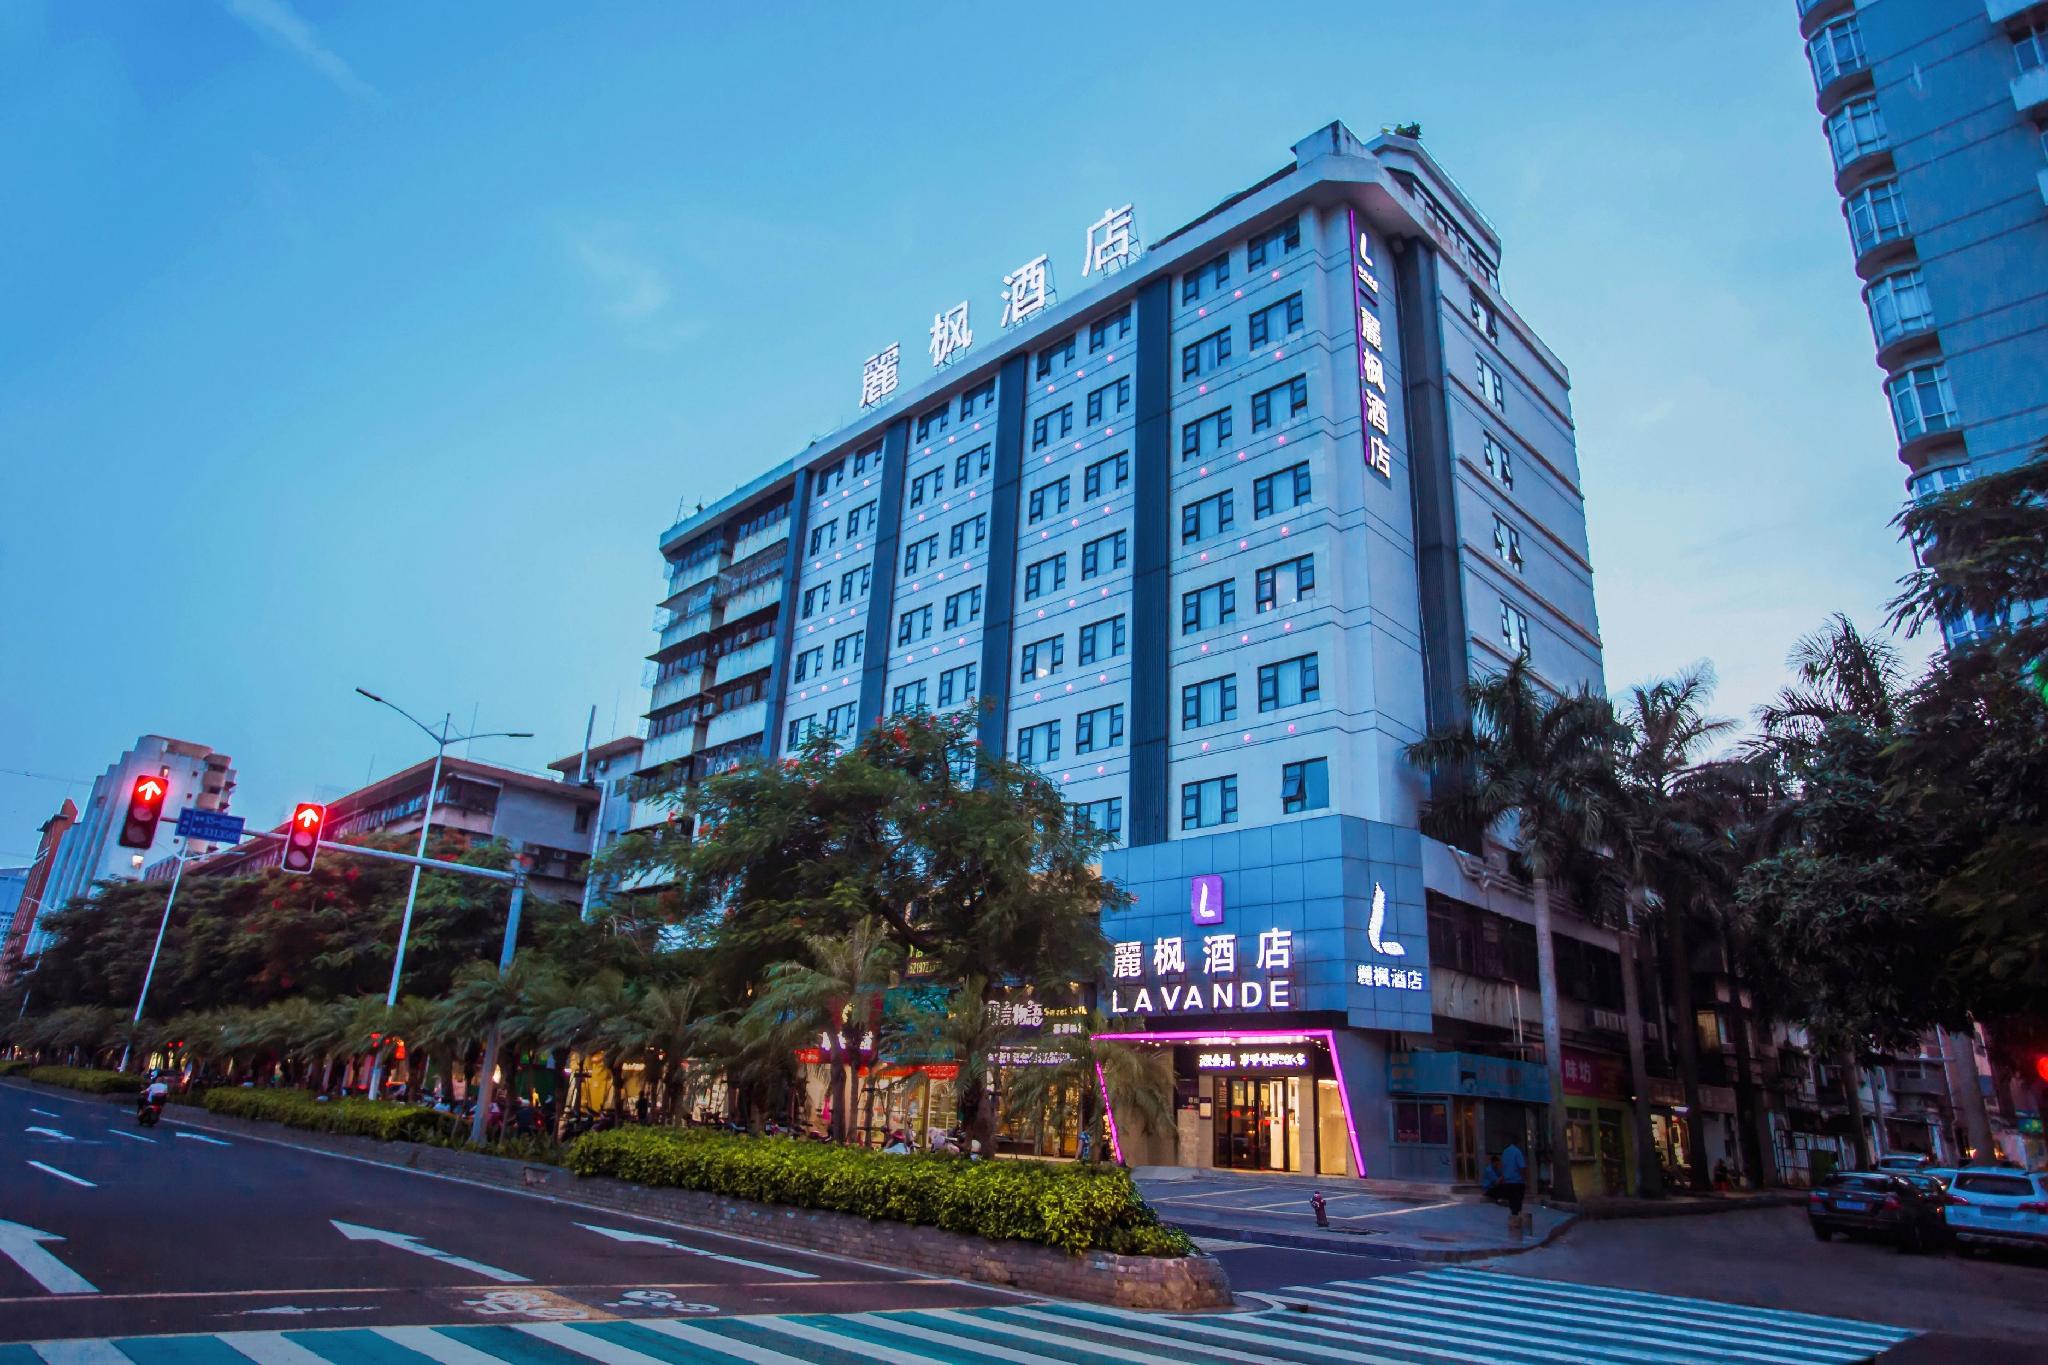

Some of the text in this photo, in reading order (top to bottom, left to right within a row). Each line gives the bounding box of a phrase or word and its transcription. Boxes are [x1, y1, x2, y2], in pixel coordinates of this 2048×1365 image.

[858, 202, 1135, 409] 麗枫酒店
[1112, 928, 1292, 979] 麗枫酒店
[1112, 980, 1290, 1013] LAVANDE
